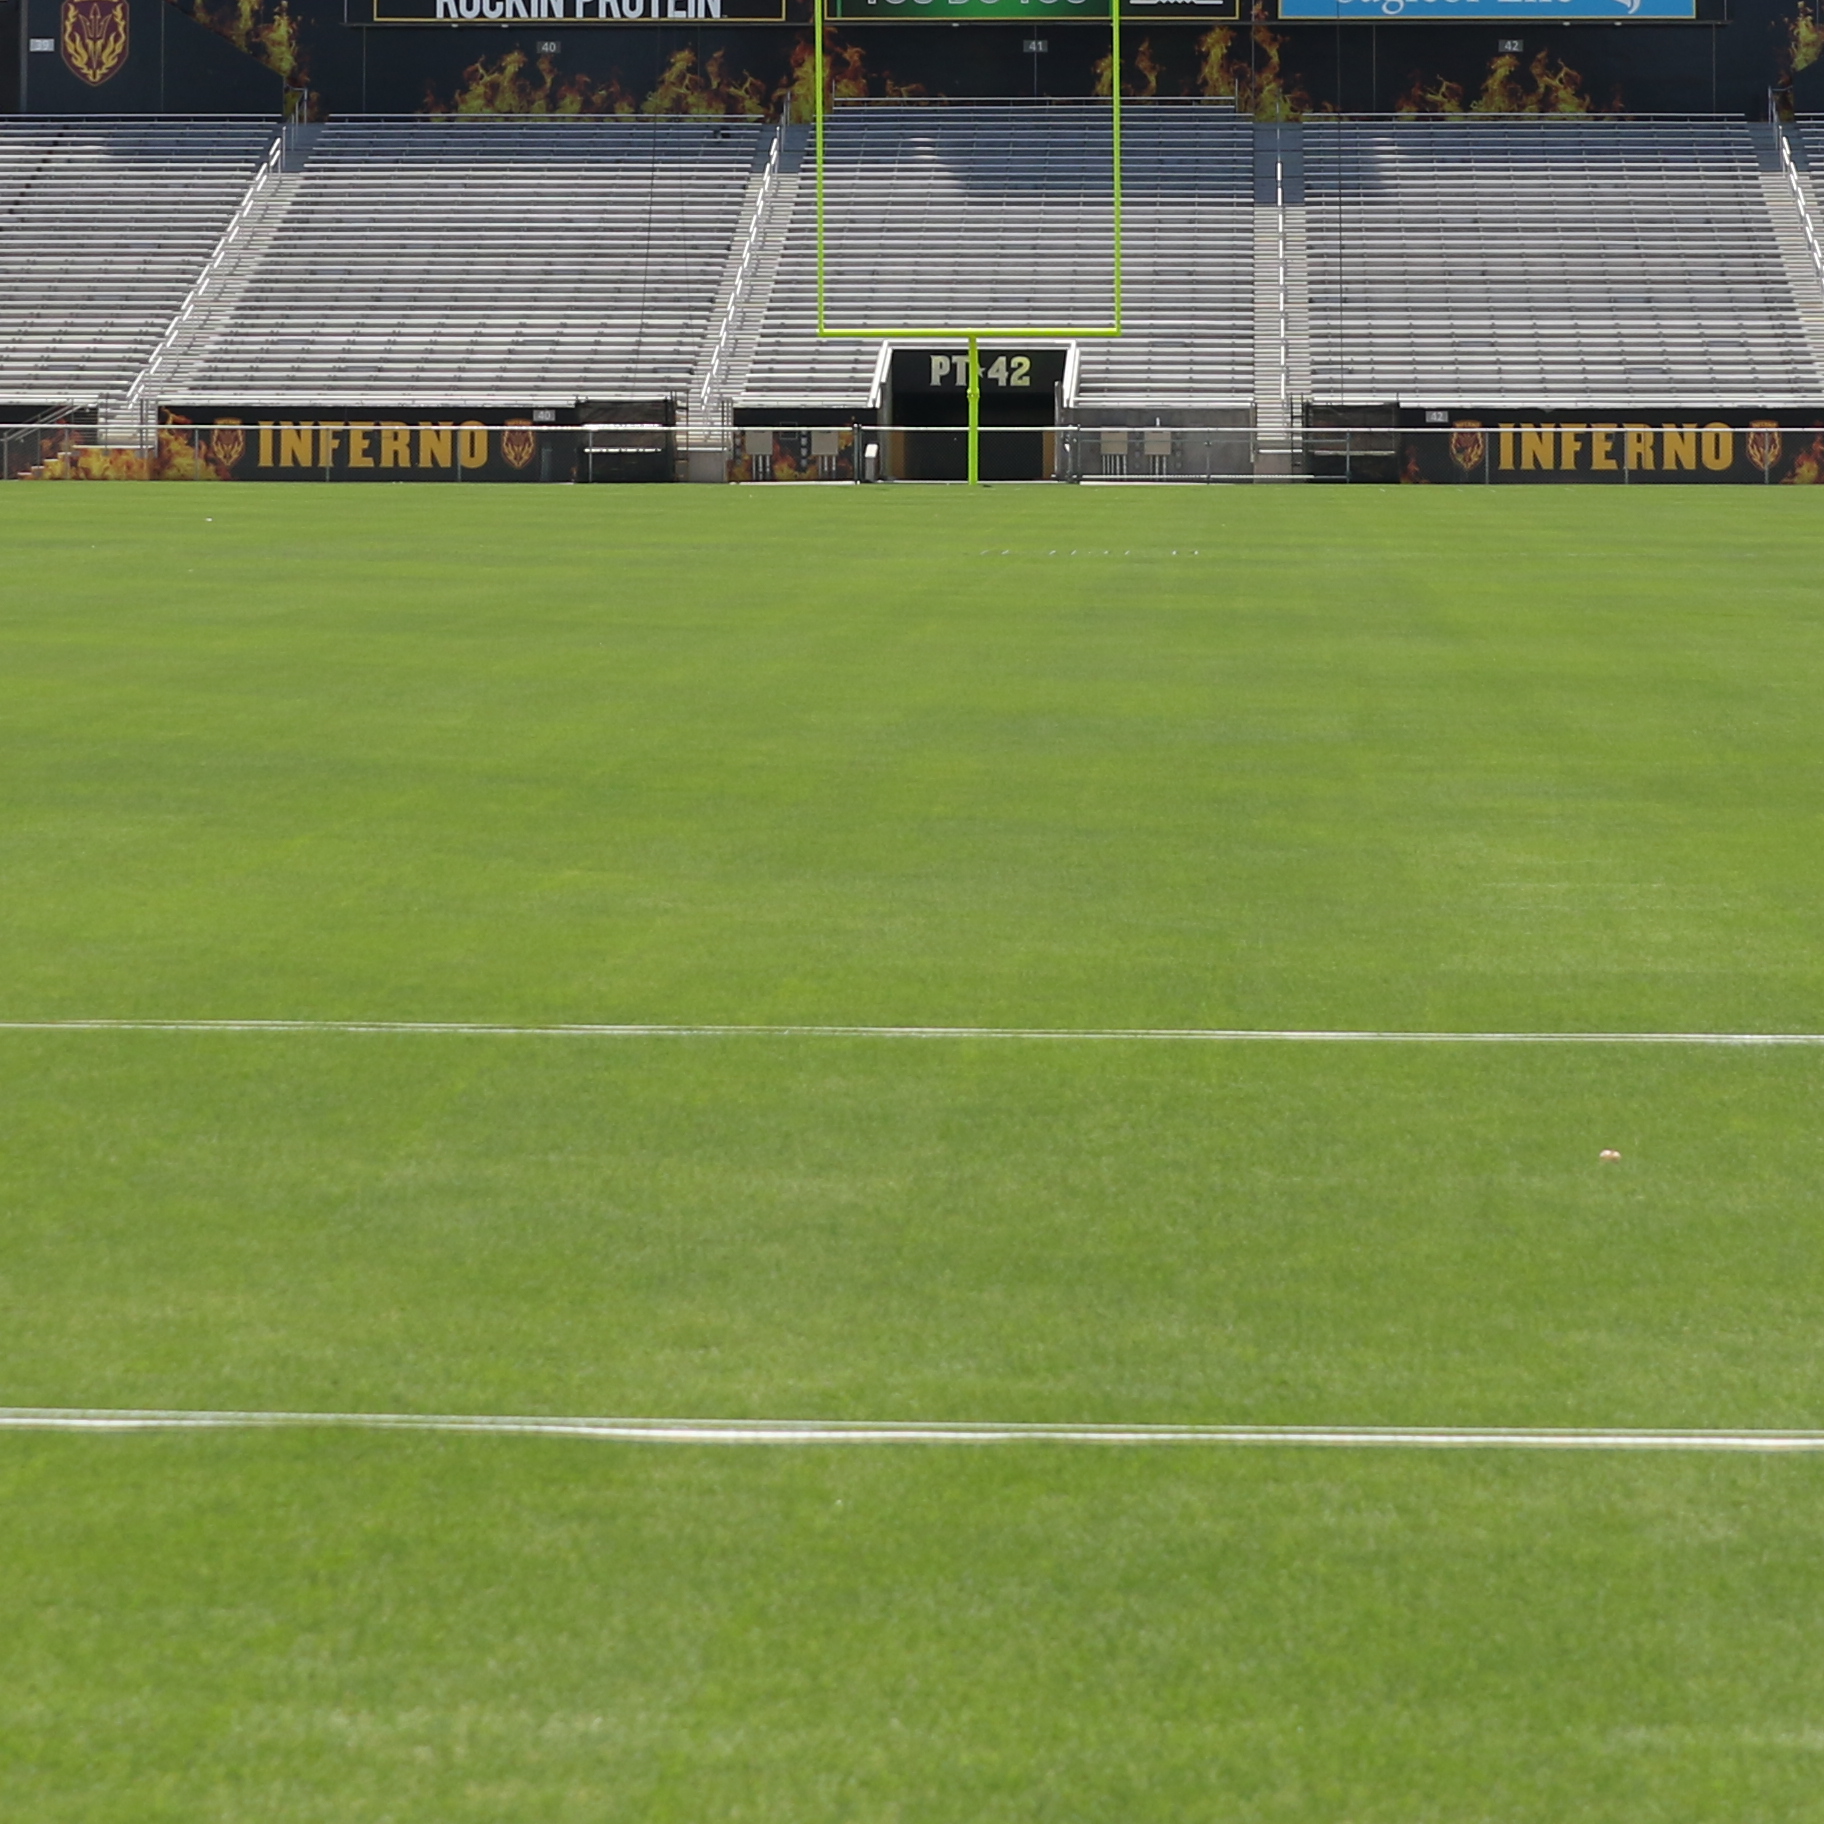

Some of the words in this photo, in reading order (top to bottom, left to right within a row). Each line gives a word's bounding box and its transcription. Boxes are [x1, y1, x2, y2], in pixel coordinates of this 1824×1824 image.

[541, 41, 556, 53] 40
[1028, 40, 1044, 53] 41
[1504, 40, 1519, 52] 42
[987, 354, 1031, 387] 42
[258, 420, 488, 468] INFERNO
[1498, 422, 1733, 471] INFERNO
